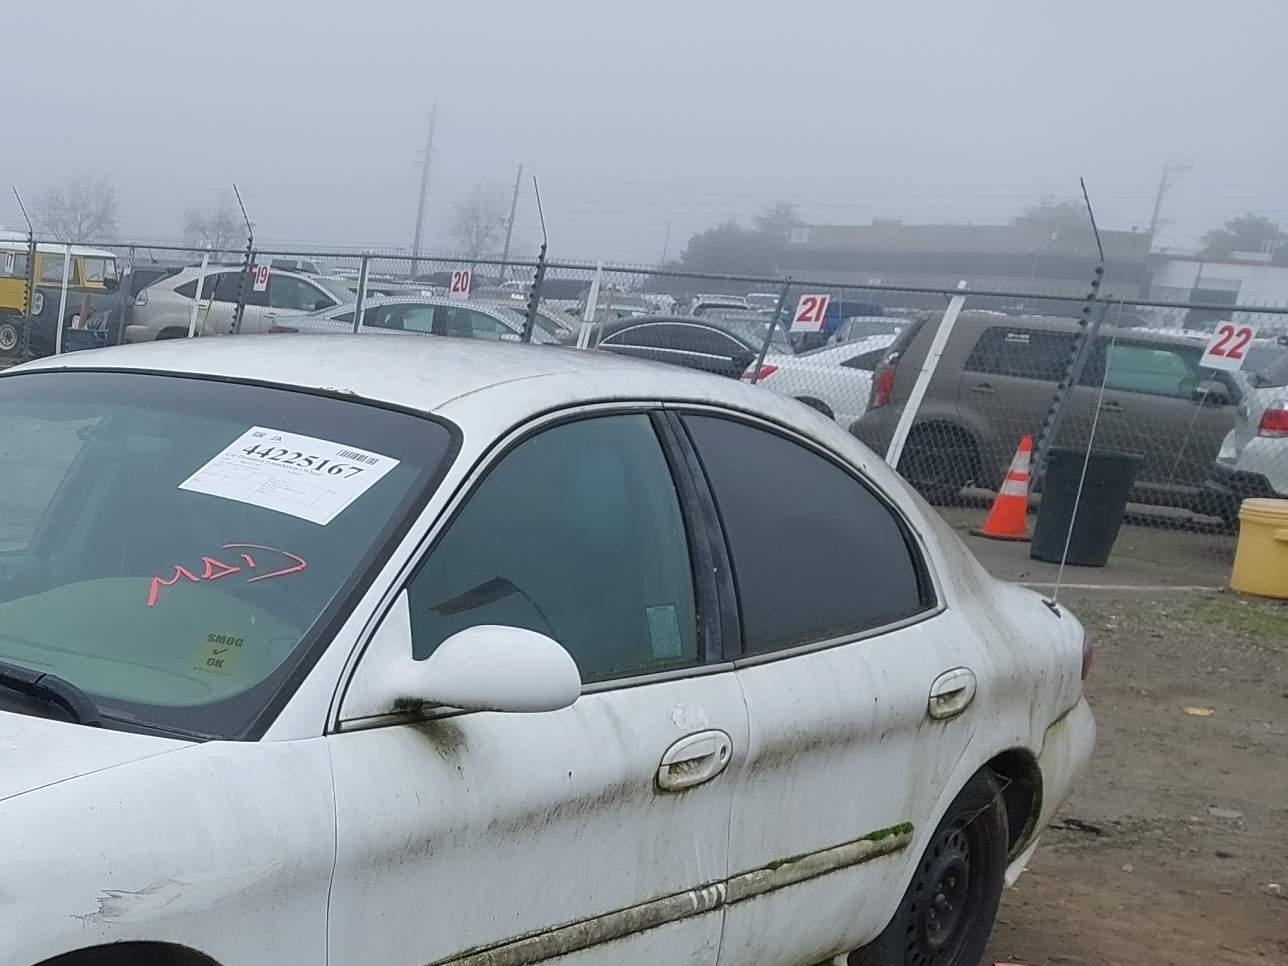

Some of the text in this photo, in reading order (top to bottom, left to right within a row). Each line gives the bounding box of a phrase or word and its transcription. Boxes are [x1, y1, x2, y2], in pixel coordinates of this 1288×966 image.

[255, 265, 268, 284] 19
[452, 271, 469, 292] 20
[795, 297, 827, 322] 21
[1208, 324, 1253, 360] 22
[241, 443, 364, 479] 44225167
[207, 632, 244, 648] SMOG
[206, 657, 225, 669] OK
